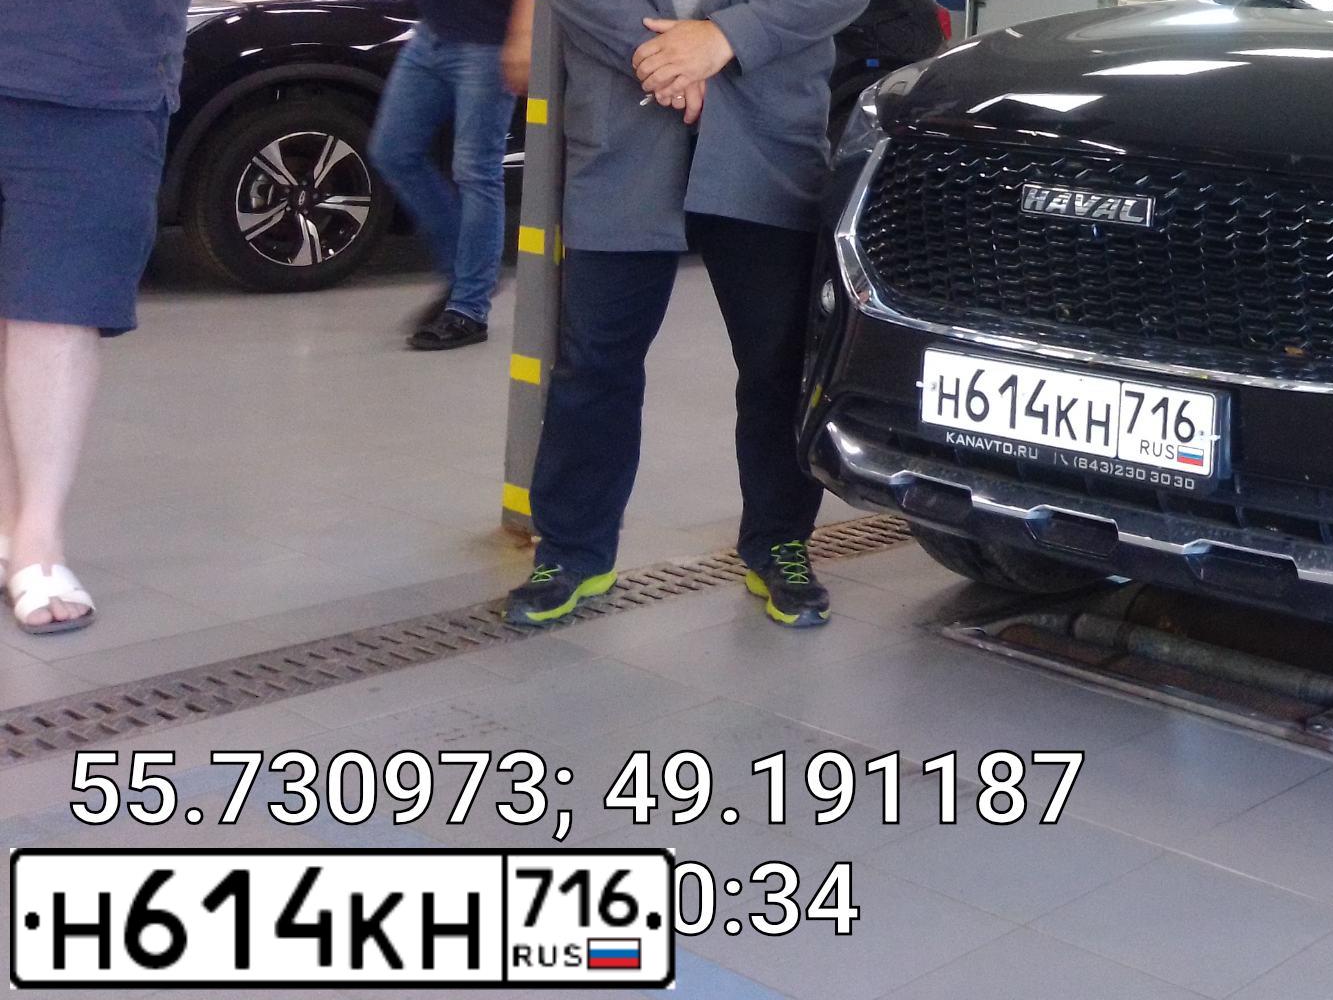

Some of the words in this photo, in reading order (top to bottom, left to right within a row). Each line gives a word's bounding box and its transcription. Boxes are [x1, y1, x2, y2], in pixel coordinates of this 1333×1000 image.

[1023, 188, 1145, 223] HAVAL
[1124, 390, 1196, 443] 716
[945, 431, 1039, 460] KANAVTO.RU
[1073, 455, 1147, 481] (843)230
[1150, 470, 1171, 486] 30
[1173, 474, 1196, 491] 30
[1139, 439, 1176, 461] RUS
